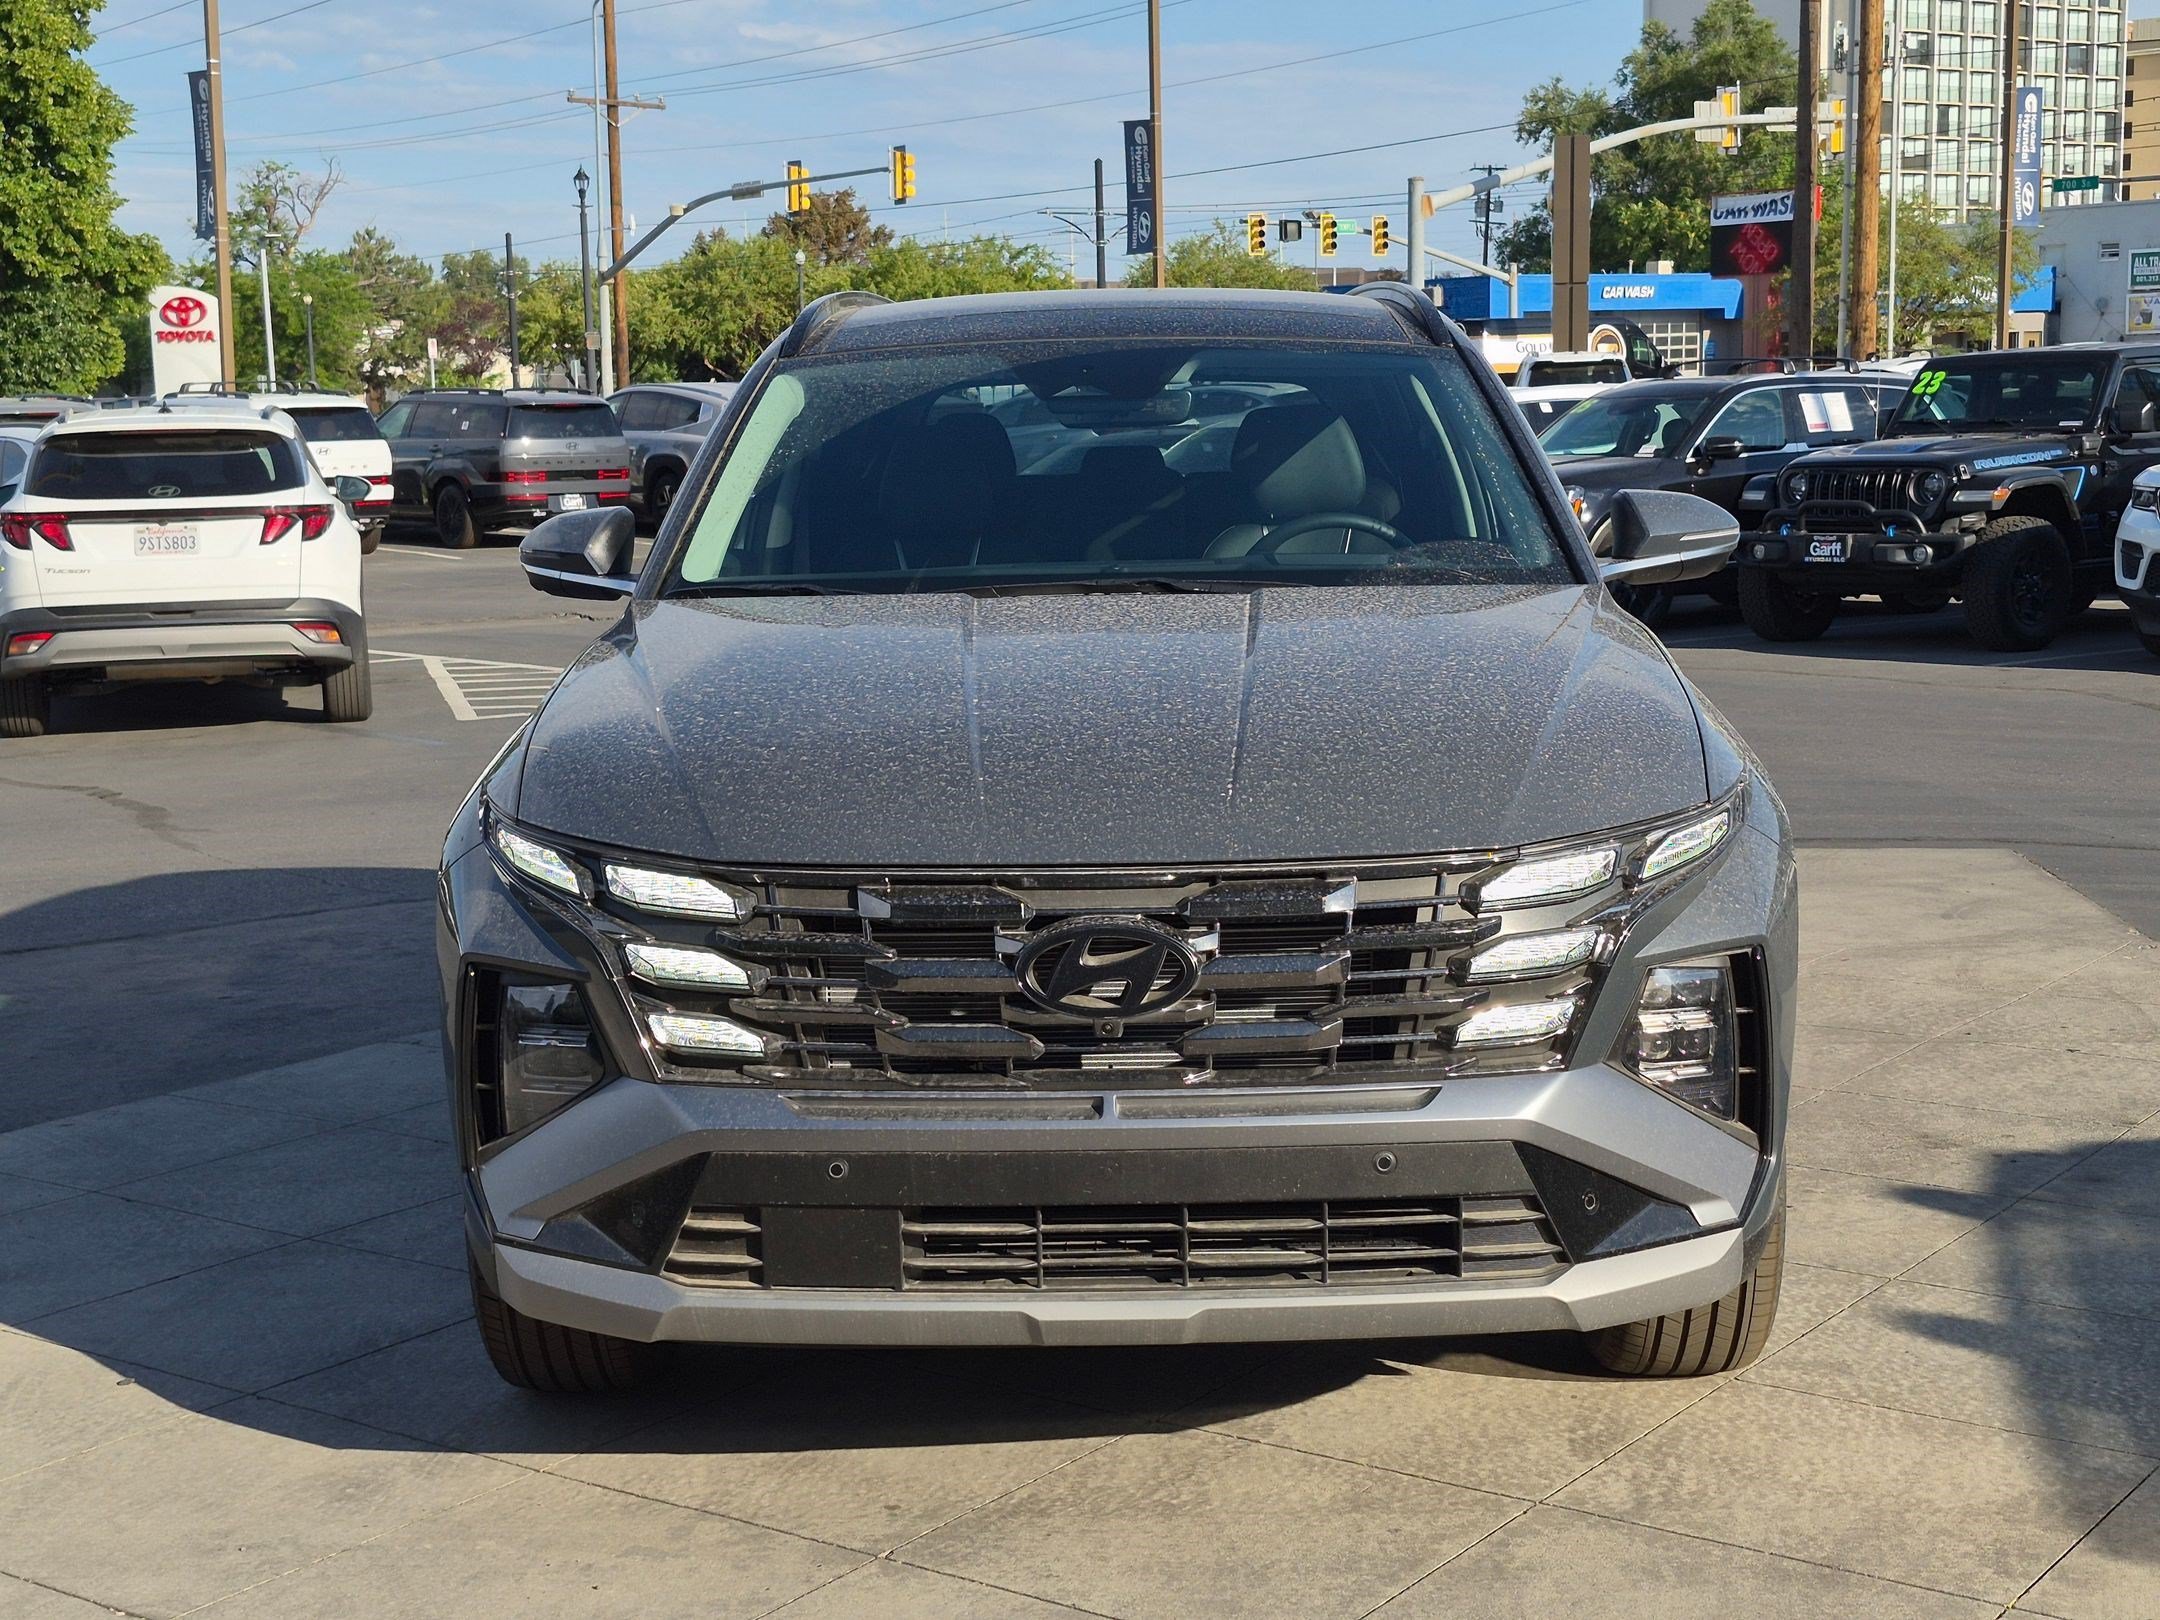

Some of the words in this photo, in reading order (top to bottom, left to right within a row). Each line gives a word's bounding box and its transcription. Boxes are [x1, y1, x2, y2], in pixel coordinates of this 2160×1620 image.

[201, 103, 212, 163] Hyundai
[2021, 114, 2031, 164] Hyundai
[1134, 145, 1145, 194] Hyundai
[2061, 180, 2077, 189] 700
[2014, 177, 2022, 221] HYUNDAI
[2133, 256, 2148, 267] ALL
[1601, 286, 1625, 299] CAR
[1624, 286, 1655, 298] WASH
[155, 331, 216, 343] TOYOTA
[1911, 371, 1946, 394] 23
[1973, 450, 2052, 470] RUBICON
[139, 535, 197, 551] 9STS803
[1810, 541, 1842, 556] Garff
